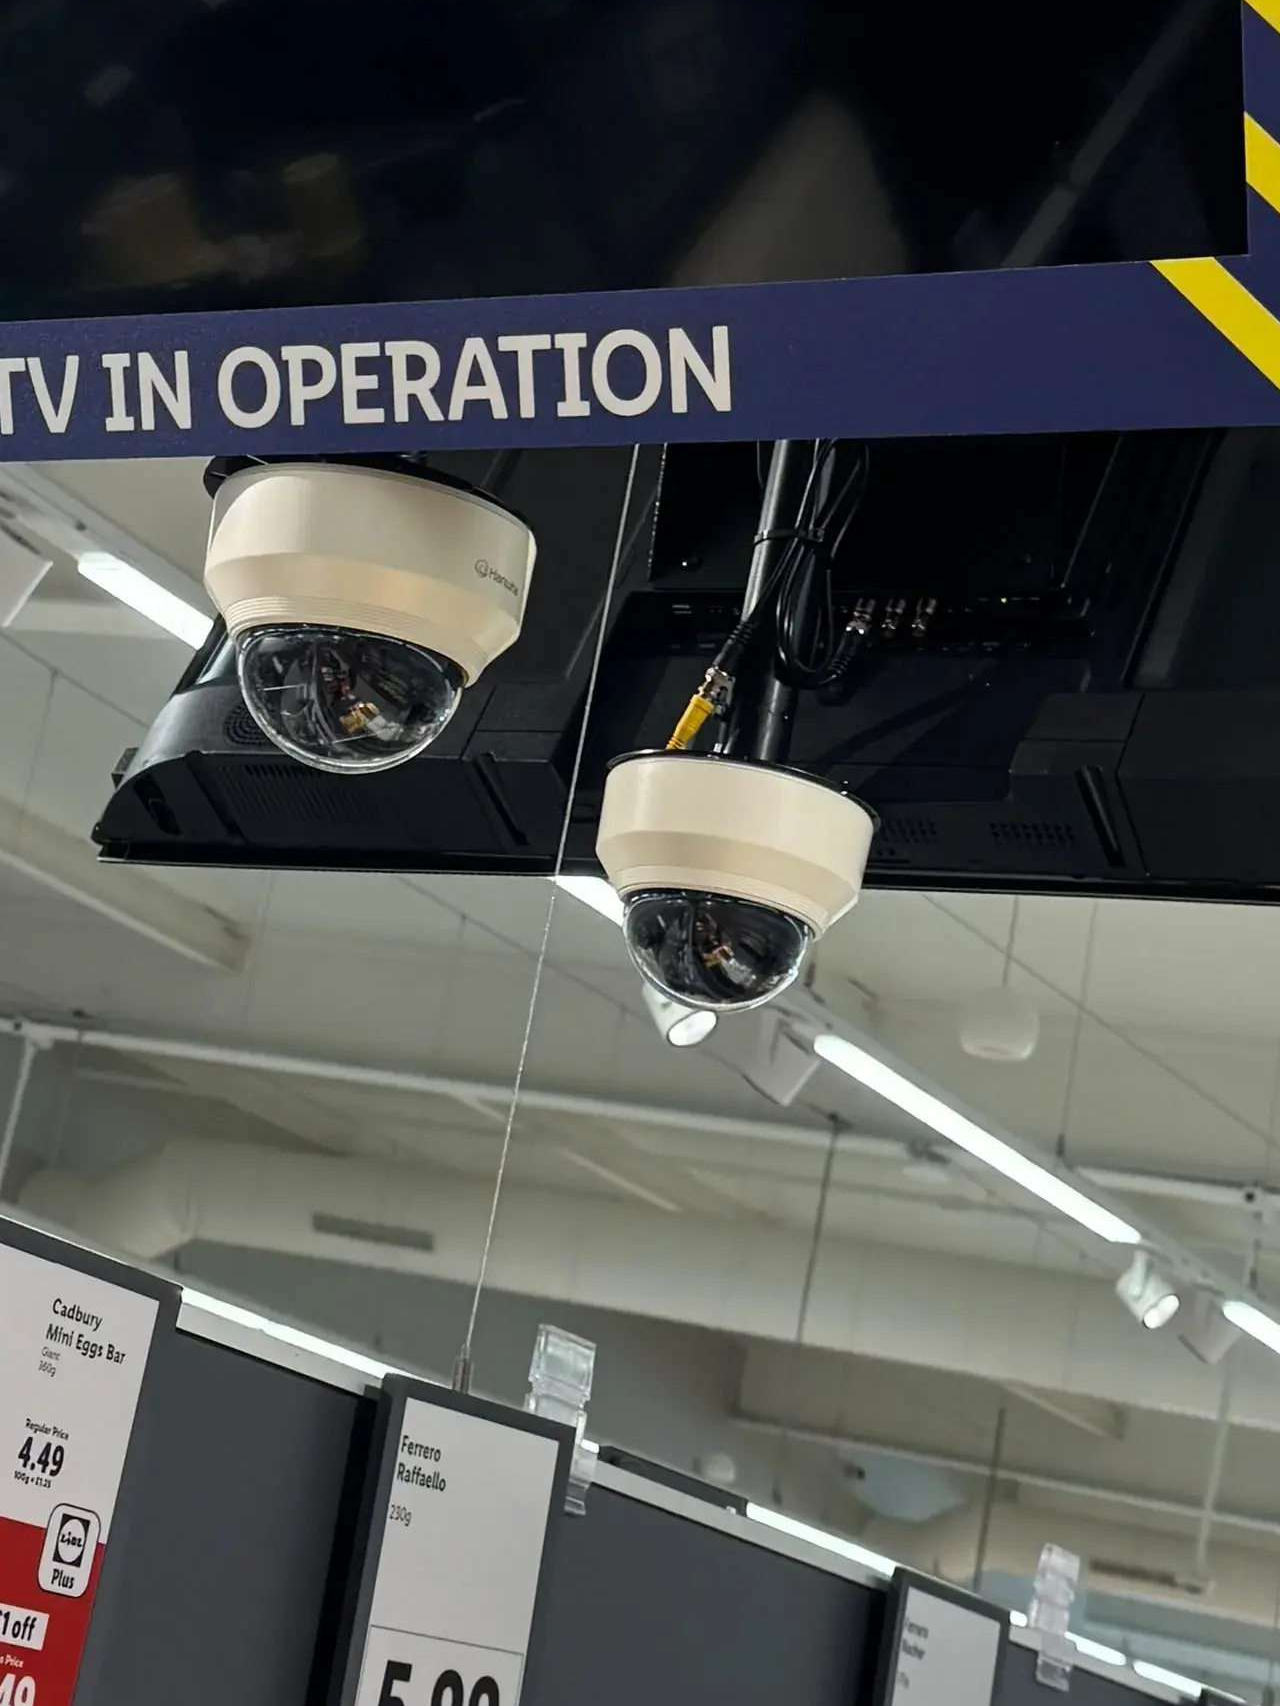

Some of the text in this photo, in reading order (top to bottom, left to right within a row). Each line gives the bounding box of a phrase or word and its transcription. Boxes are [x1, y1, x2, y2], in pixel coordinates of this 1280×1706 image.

[101, 349, 193, 432] IN
[217, 324, 732, 430] OPERATION
[52, 1298, 103, 1332] Cadbury
[45, 1323, 126, 1365] Mini Eggs Bar
[18, 1436, 66, 1477] 4.49
[400, 1434, 442, 1463] Ferrero
[396, 1462, 447, 1492] Raffaello
[389, 1504, 412, 1527] 230g
[51, 1568, 75, 1590] Plus
[11, 1614, 38, 1642] off
